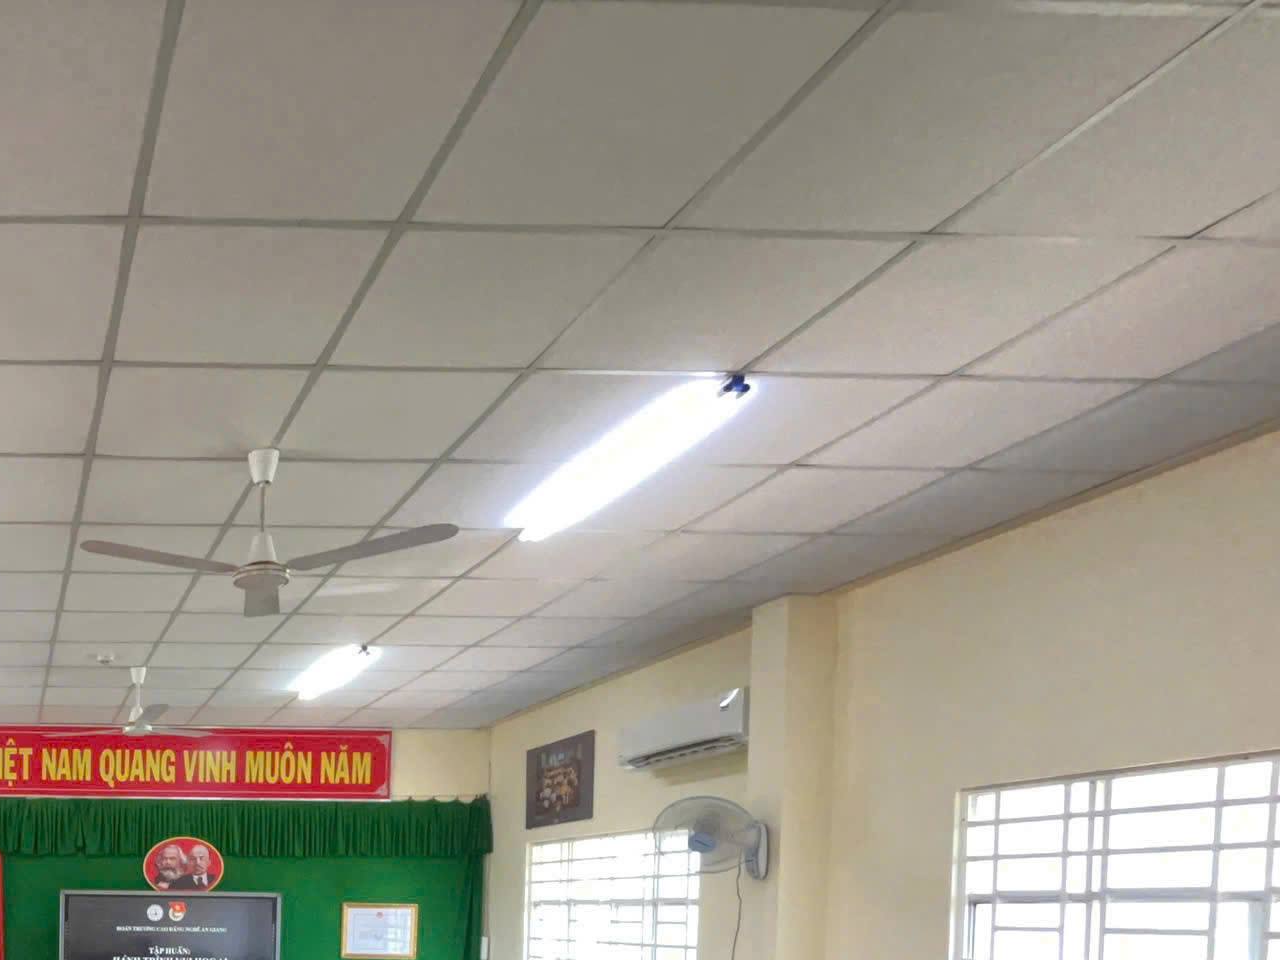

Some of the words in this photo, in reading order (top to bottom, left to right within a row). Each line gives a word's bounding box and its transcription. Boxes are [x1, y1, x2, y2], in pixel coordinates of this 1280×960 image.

[41, 747, 92, 782] NAM
[99, 748, 176, 789] QUANG
[183, 750, 237, 784] VINH
[244, 741, 313, 785] MUÔN
[320, 744, 372, 785] NĂM
